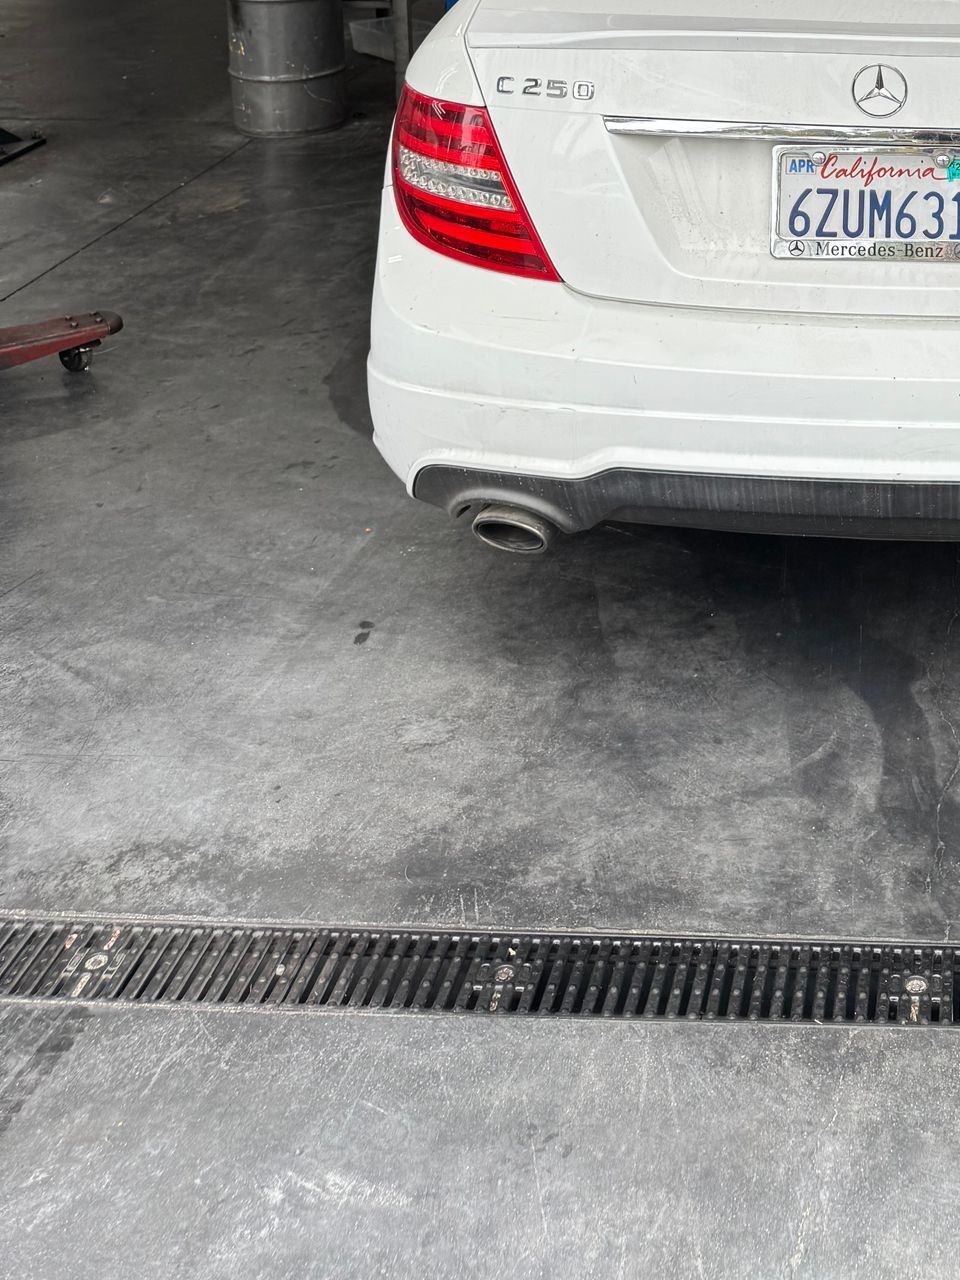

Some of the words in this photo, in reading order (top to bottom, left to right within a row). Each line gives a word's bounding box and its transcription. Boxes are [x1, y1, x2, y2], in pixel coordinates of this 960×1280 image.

[496, 76, 515, 95] C
[522, 78, 595, 101] 250
[789, 158, 815, 174] APR
[820, 153, 949, 187] California
[815, 241, 943, 258] Mercedes-Benz
